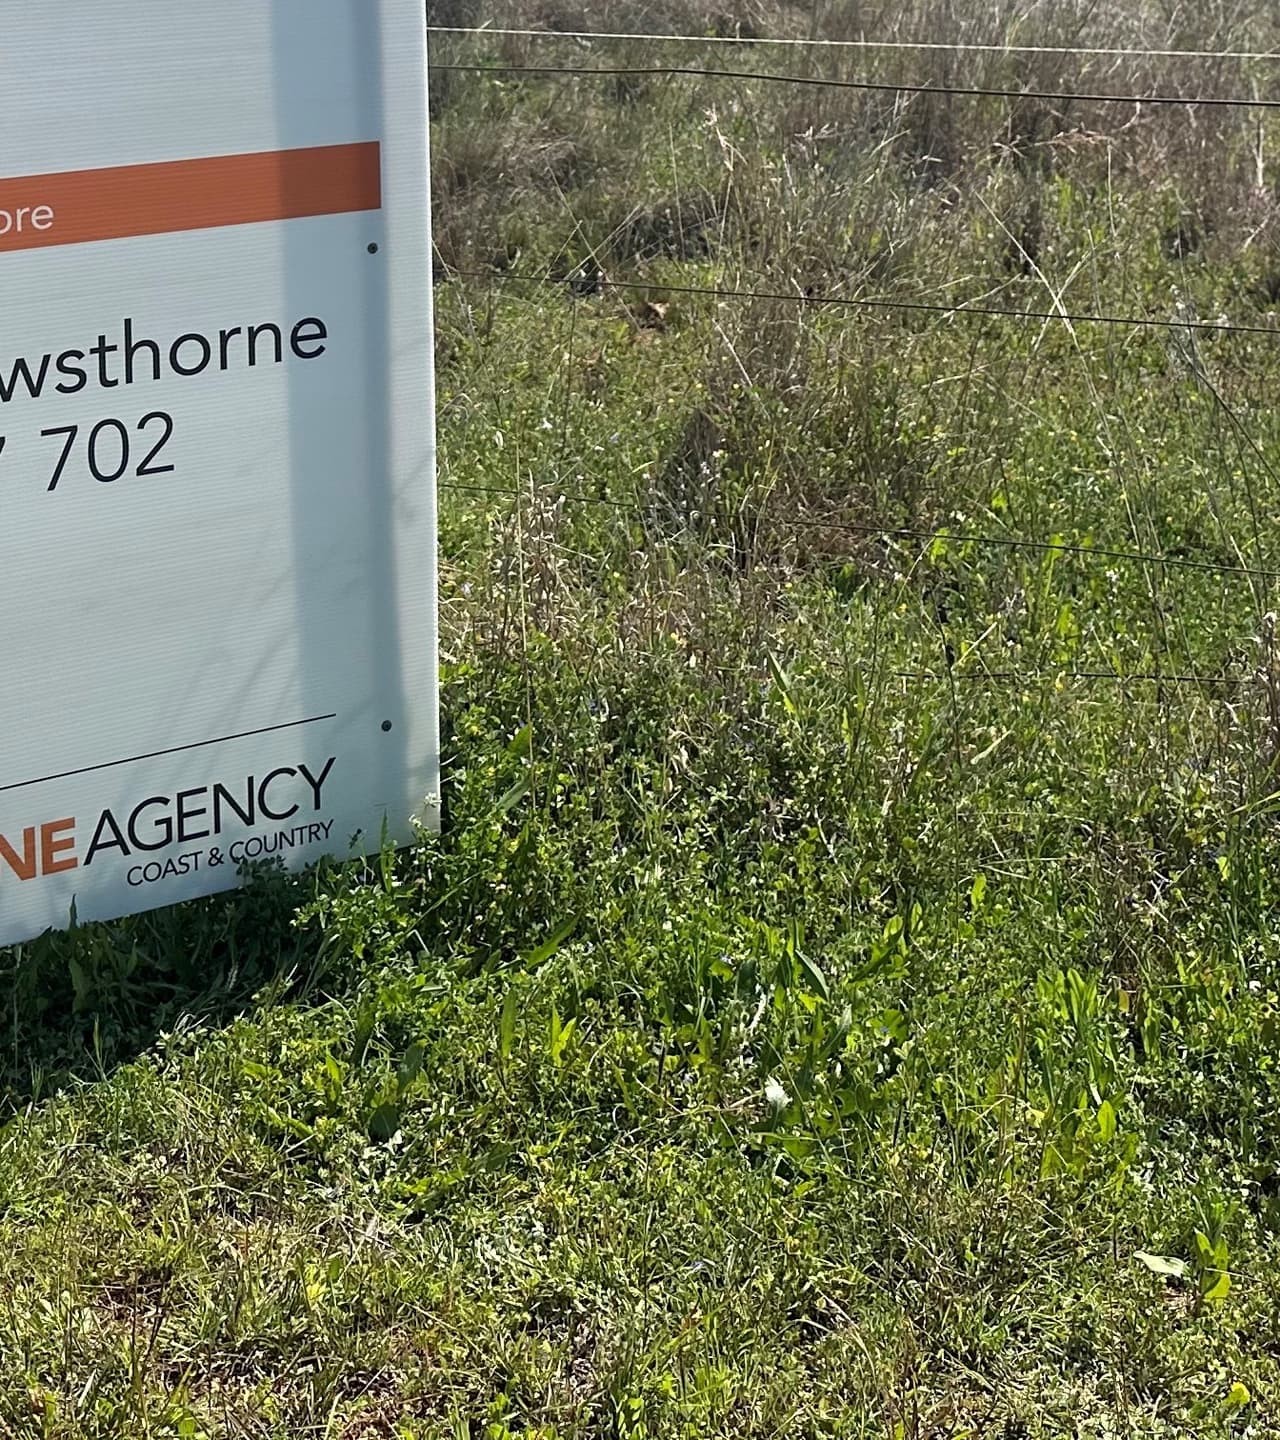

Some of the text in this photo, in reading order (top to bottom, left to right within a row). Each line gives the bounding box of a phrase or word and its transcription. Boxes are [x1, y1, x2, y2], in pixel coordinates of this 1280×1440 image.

[41, 412, 175, 491] 702
[127, 819, 335, 887] COAST & COUNTRY
